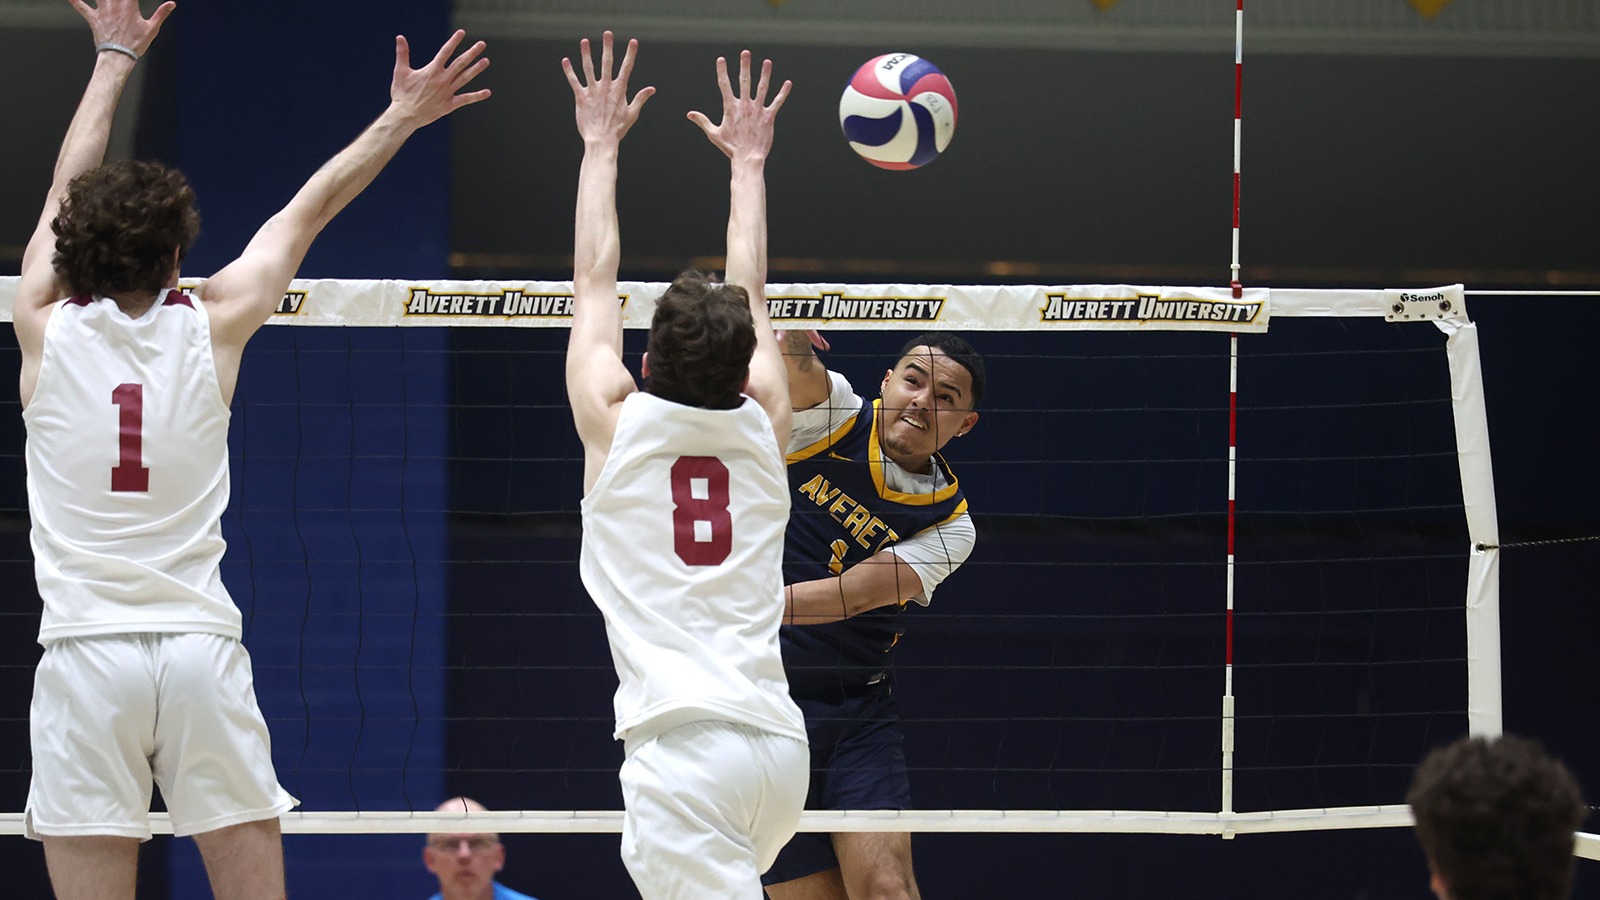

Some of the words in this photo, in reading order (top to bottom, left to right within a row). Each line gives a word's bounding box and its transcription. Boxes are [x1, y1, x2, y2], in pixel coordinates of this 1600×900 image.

[882, 54, 911, 70] CAA
[409, 290, 500, 314] AVERETT
[503, 292, 574, 315] UNIVER
[768, 299, 819, 318] RETT
[822, 295, 941, 319] UNIVERSITY
[1045, 296, 1135, 319] AVERETT
[1137, 297, 1259, 321] UNIVERSITY
[1410, 293, 1444, 302] Senoh
[111, 383, 149, 492] 1
[670, 455, 733, 566] 8
[798, 474, 900, 554] AVERET
